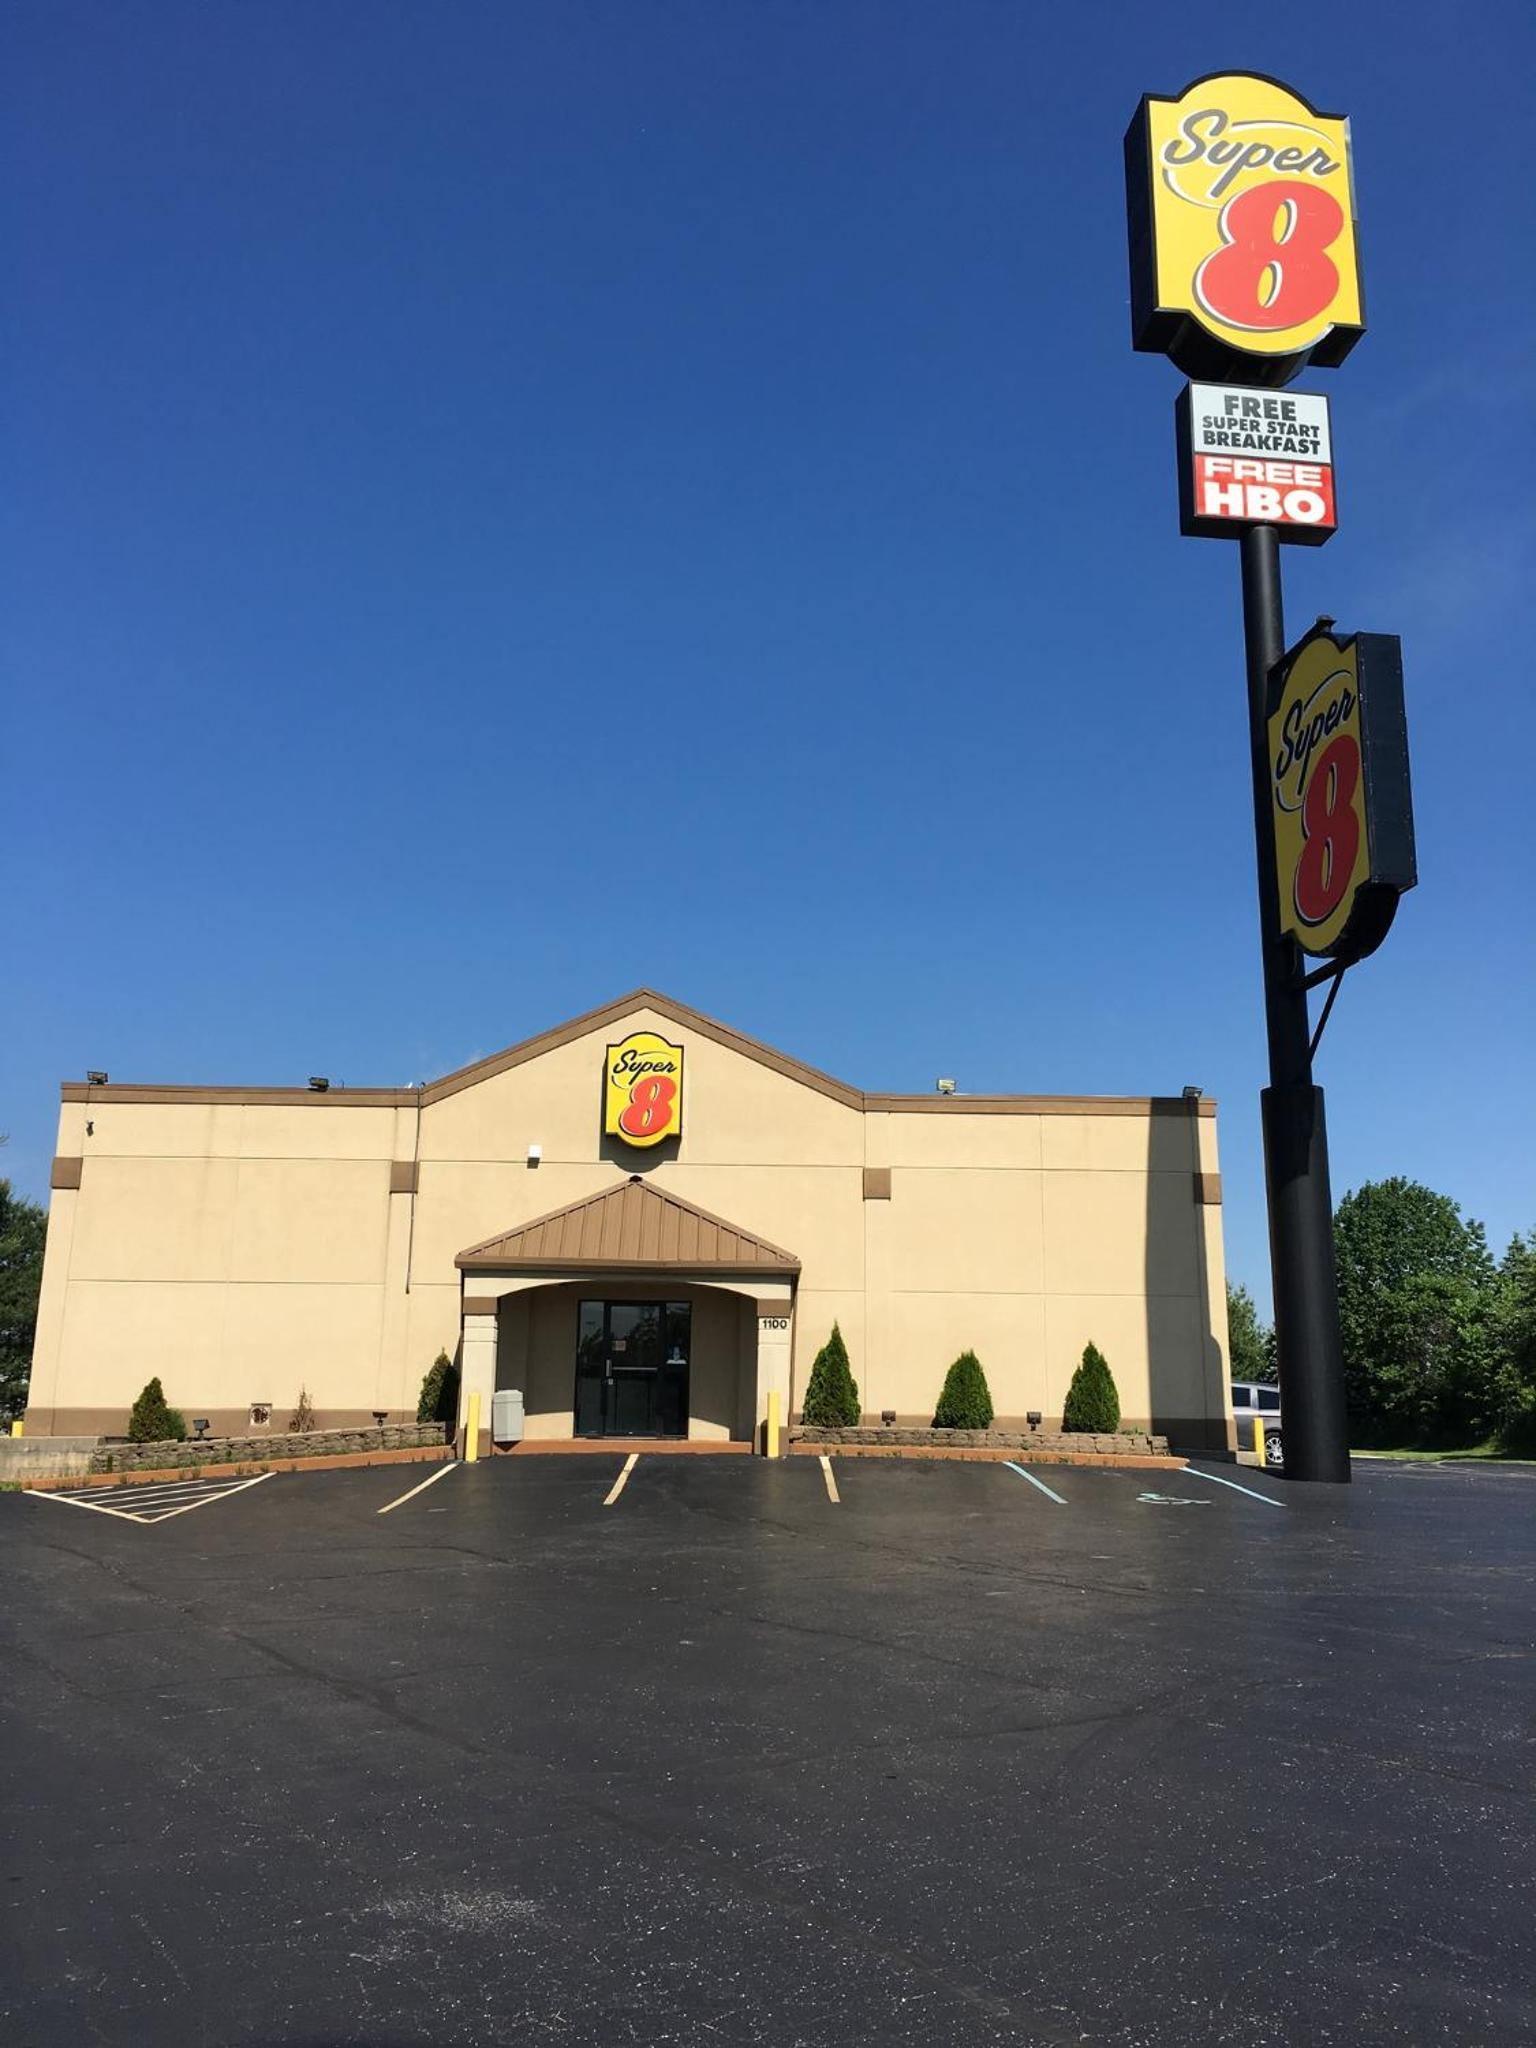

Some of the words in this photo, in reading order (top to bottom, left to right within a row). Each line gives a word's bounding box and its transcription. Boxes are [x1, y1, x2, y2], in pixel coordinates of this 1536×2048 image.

[1162, 108, 1341, 198] Super
[1192, 179, 1345, 333] 8
[1202, 415, 1261, 433] SUPER
[1267, 421, 1320, 438] START
[1224, 394, 1297, 421] FREE
[1203, 429, 1321, 455] BREAKFAST
[1203, 456, 1323, 487] FREE
[1203, 481, 1326, 523] HBO
[1275, 687, 1357, 796] Super
[1294, 733, 1360, 927] 8
[612, 1049, 678, 1086] Super
[618, 1075, 677, 1137] 8
[762, 1319, 788, 1330] 1100
